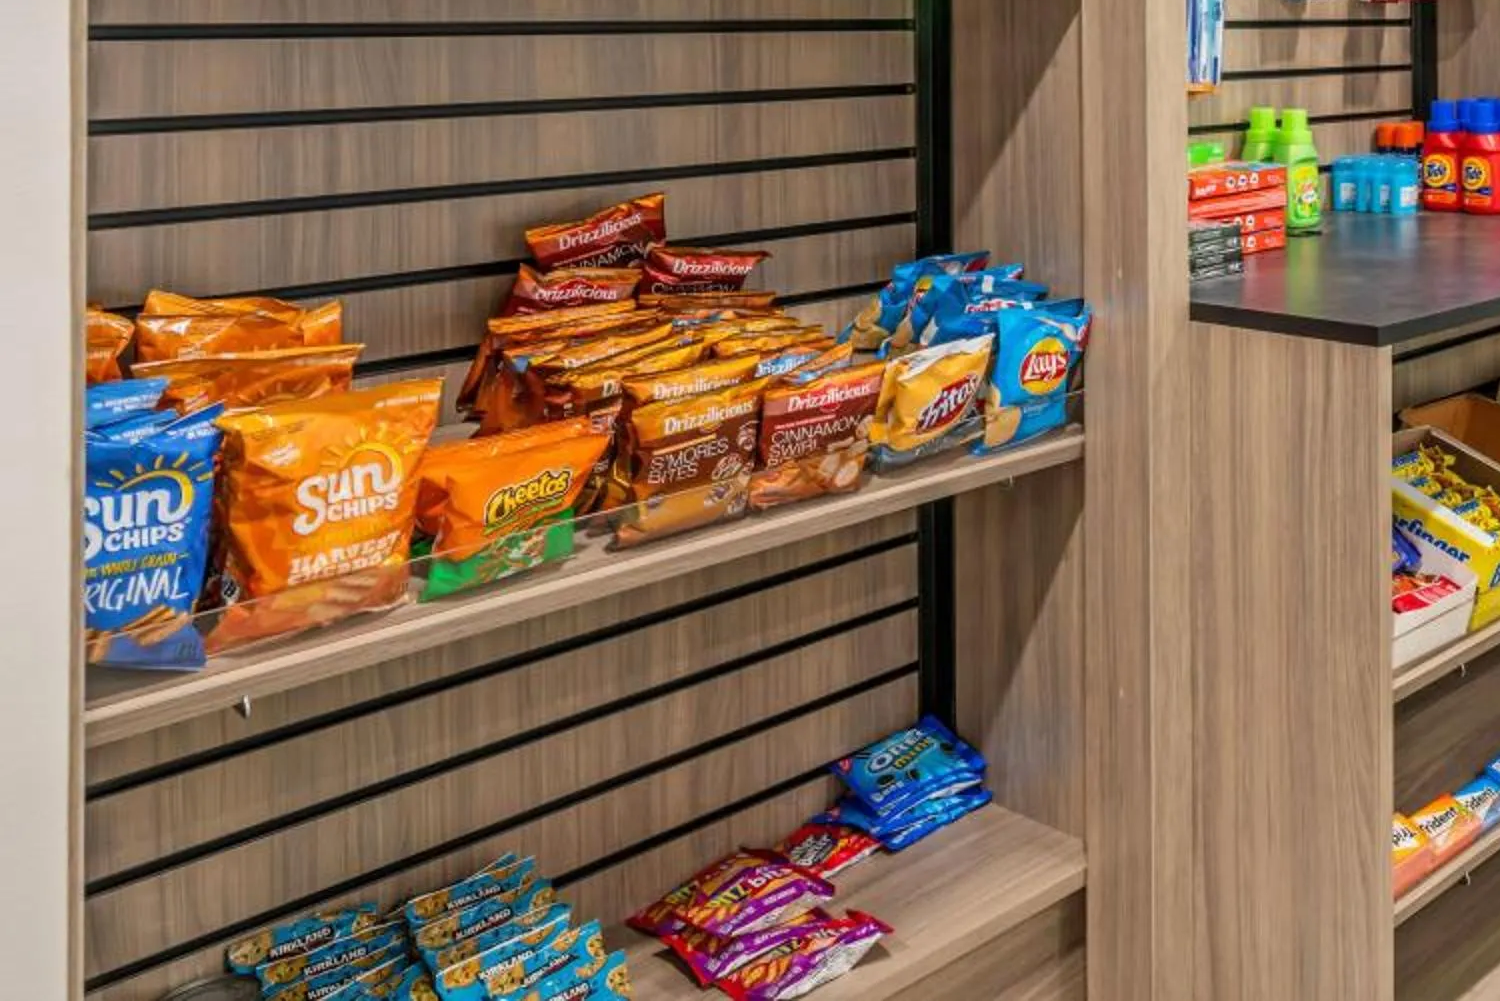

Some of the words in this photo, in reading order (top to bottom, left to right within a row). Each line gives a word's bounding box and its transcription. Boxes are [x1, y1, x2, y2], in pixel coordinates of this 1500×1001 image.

[787, 382, 871, 412] Drizzilicious
[664, 401, 754, 436] Drizzilicious
[771, 415, 862, 444] CINNAMON
[647, 461, 699, 484] BITES
[293, 458, 402, 535] Sun
[327, 492, 400, 523] CHIPS
[487, 470, 572, 522] Cheetos
[103, 522, 187, 553] CHIPS
[85, 567, 190, 614] RIGINAL
[1418, 807, 1457, 834] Trident
[447, 885, 501, 910] KIRKLAND
[455, 909, 512, 939] KIRKLAND
[269, 927, 332, 958] KIRKLAND
[304, 947, 367, 976] KIRKLAND
[480, 950, 534, 981] KIRKLAND
